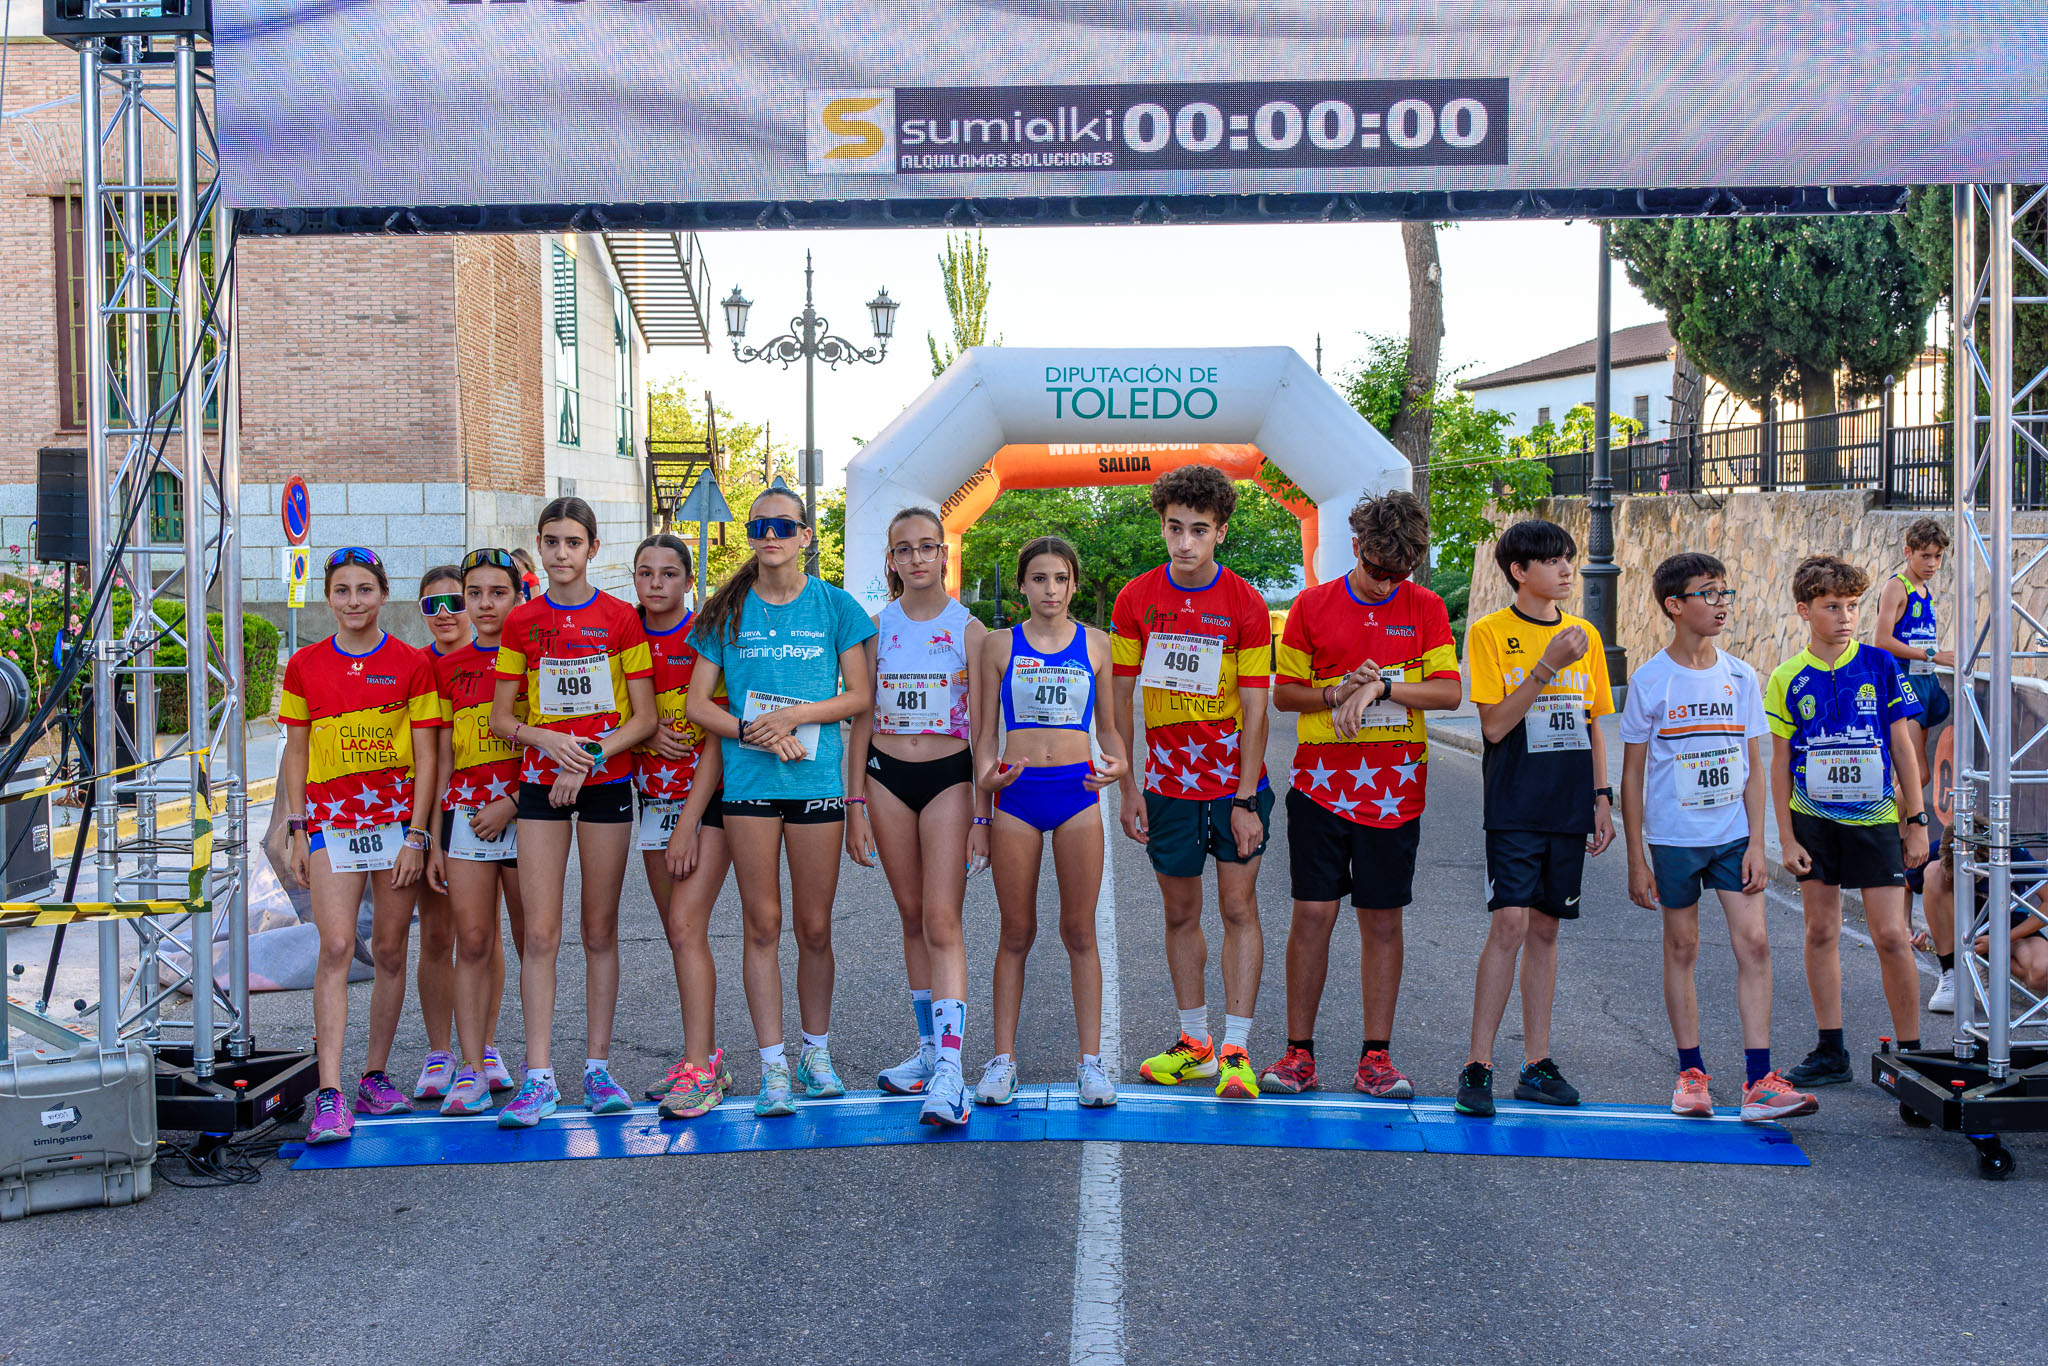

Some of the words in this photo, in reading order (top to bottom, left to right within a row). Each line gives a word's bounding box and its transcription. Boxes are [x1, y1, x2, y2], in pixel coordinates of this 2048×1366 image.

[902, 109, 1113, 143] sumialki
[1123, 99, 1488, 153] 00:00:00
[902, 154, 1007, 169] ALQUILAMOS
[1011, 152, 1113, 168] SOLUCIONES
[1046, 363, 1181, 383] DIPUTACIÓN
[1190, 367, 1217, 383] DE
[1046, 387, 1217, 419] TOLEDO
[1099, 456, 1151, 473] SALIDA
[1164, 651, 1199, 673] 496
[557, 676, 591, 695] 498
[1035, 685, 1067, 705] 476
[756, 692, 773, 701] LEGUA
[896, 691, 926, 710] 481
[1171, 697, 1225, 713] LITNER
[340, 724, 393, 738] CLÍNICA
[1549, 712, 1575, 731] 475
[341, 738, 394, 751] LACASA
[342, 751, 398, 763] LITNER
[1698, 767, 1729, 788] 486
[1827, 766, 1861, 783] 483
[349, 834, 383, 854] 488
[34, 1132, 93, 1146] timingsense
